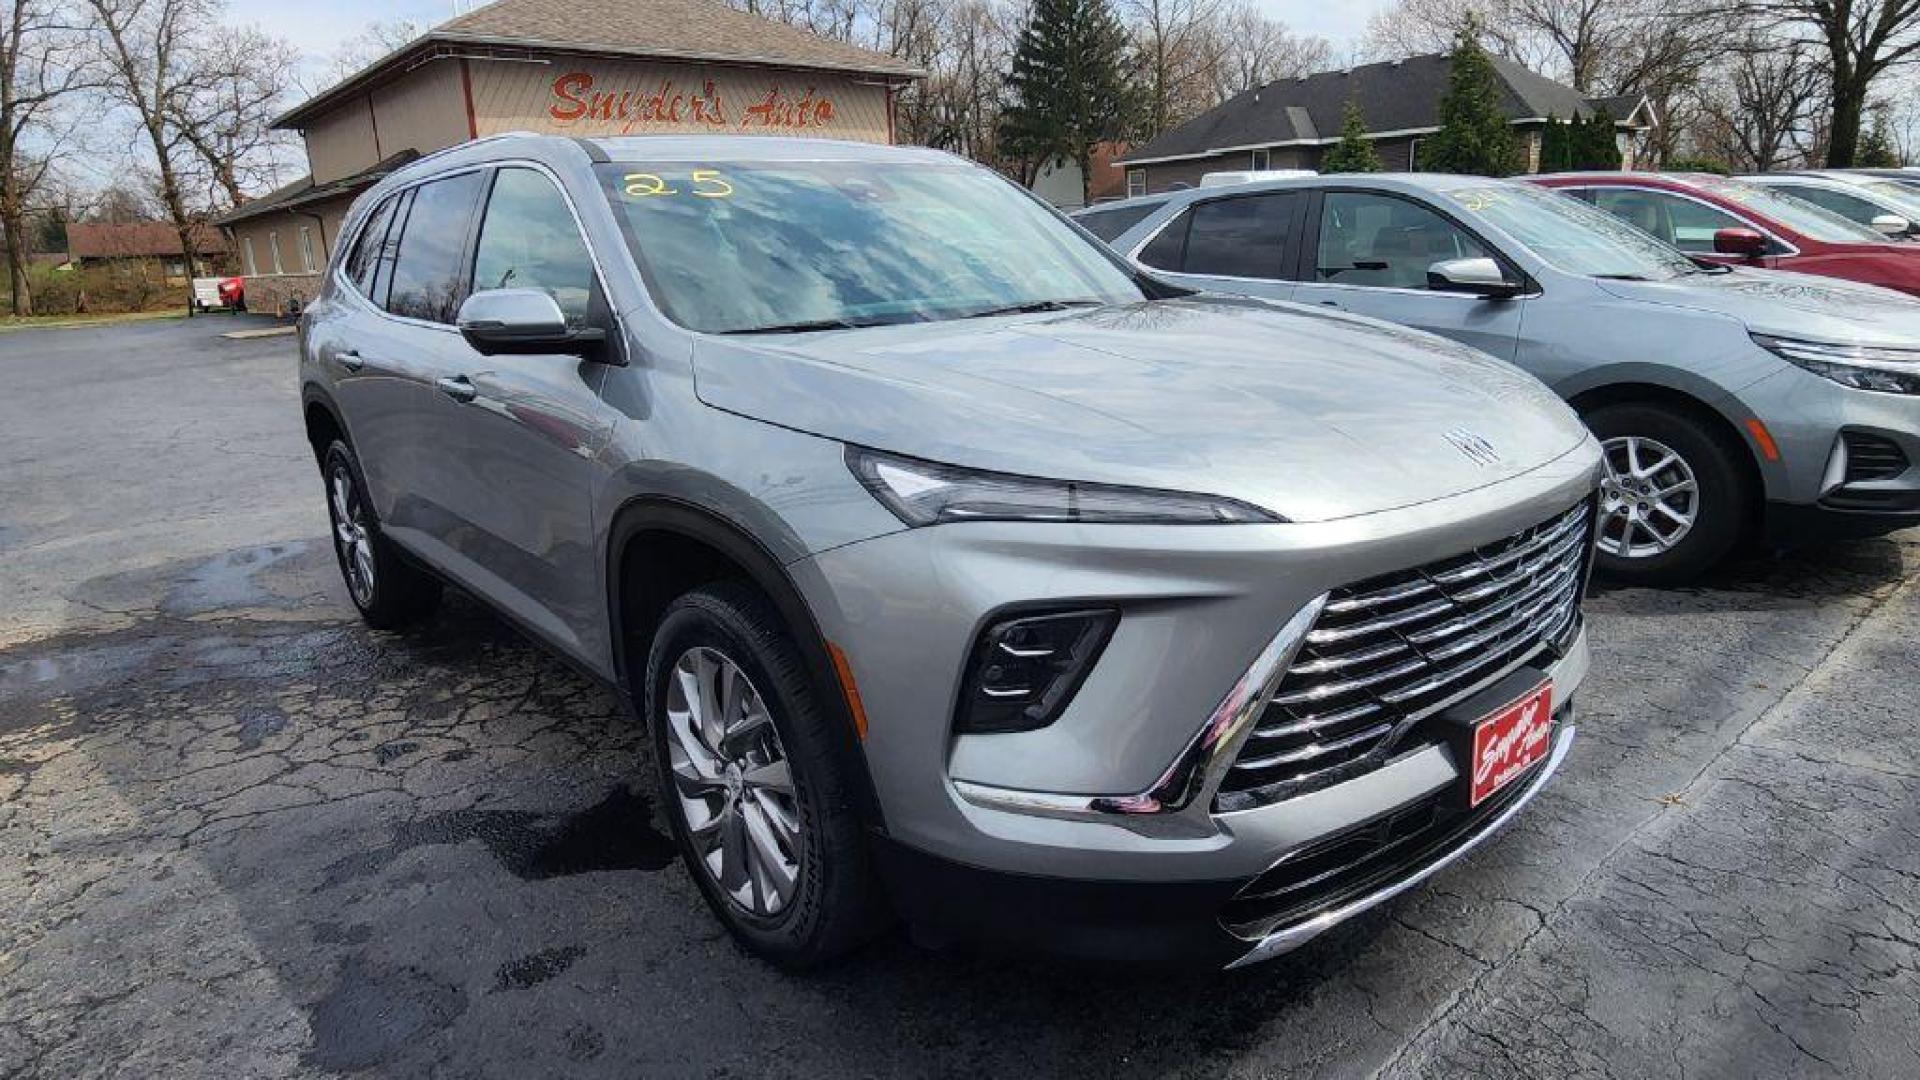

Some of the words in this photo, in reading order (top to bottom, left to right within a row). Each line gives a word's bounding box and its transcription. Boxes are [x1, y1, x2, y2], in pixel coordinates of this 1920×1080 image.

[550, 72, 726, 135] Snyder's
[741, 85, 834, 128] Auto
[623, 170, 732, 198] 25
